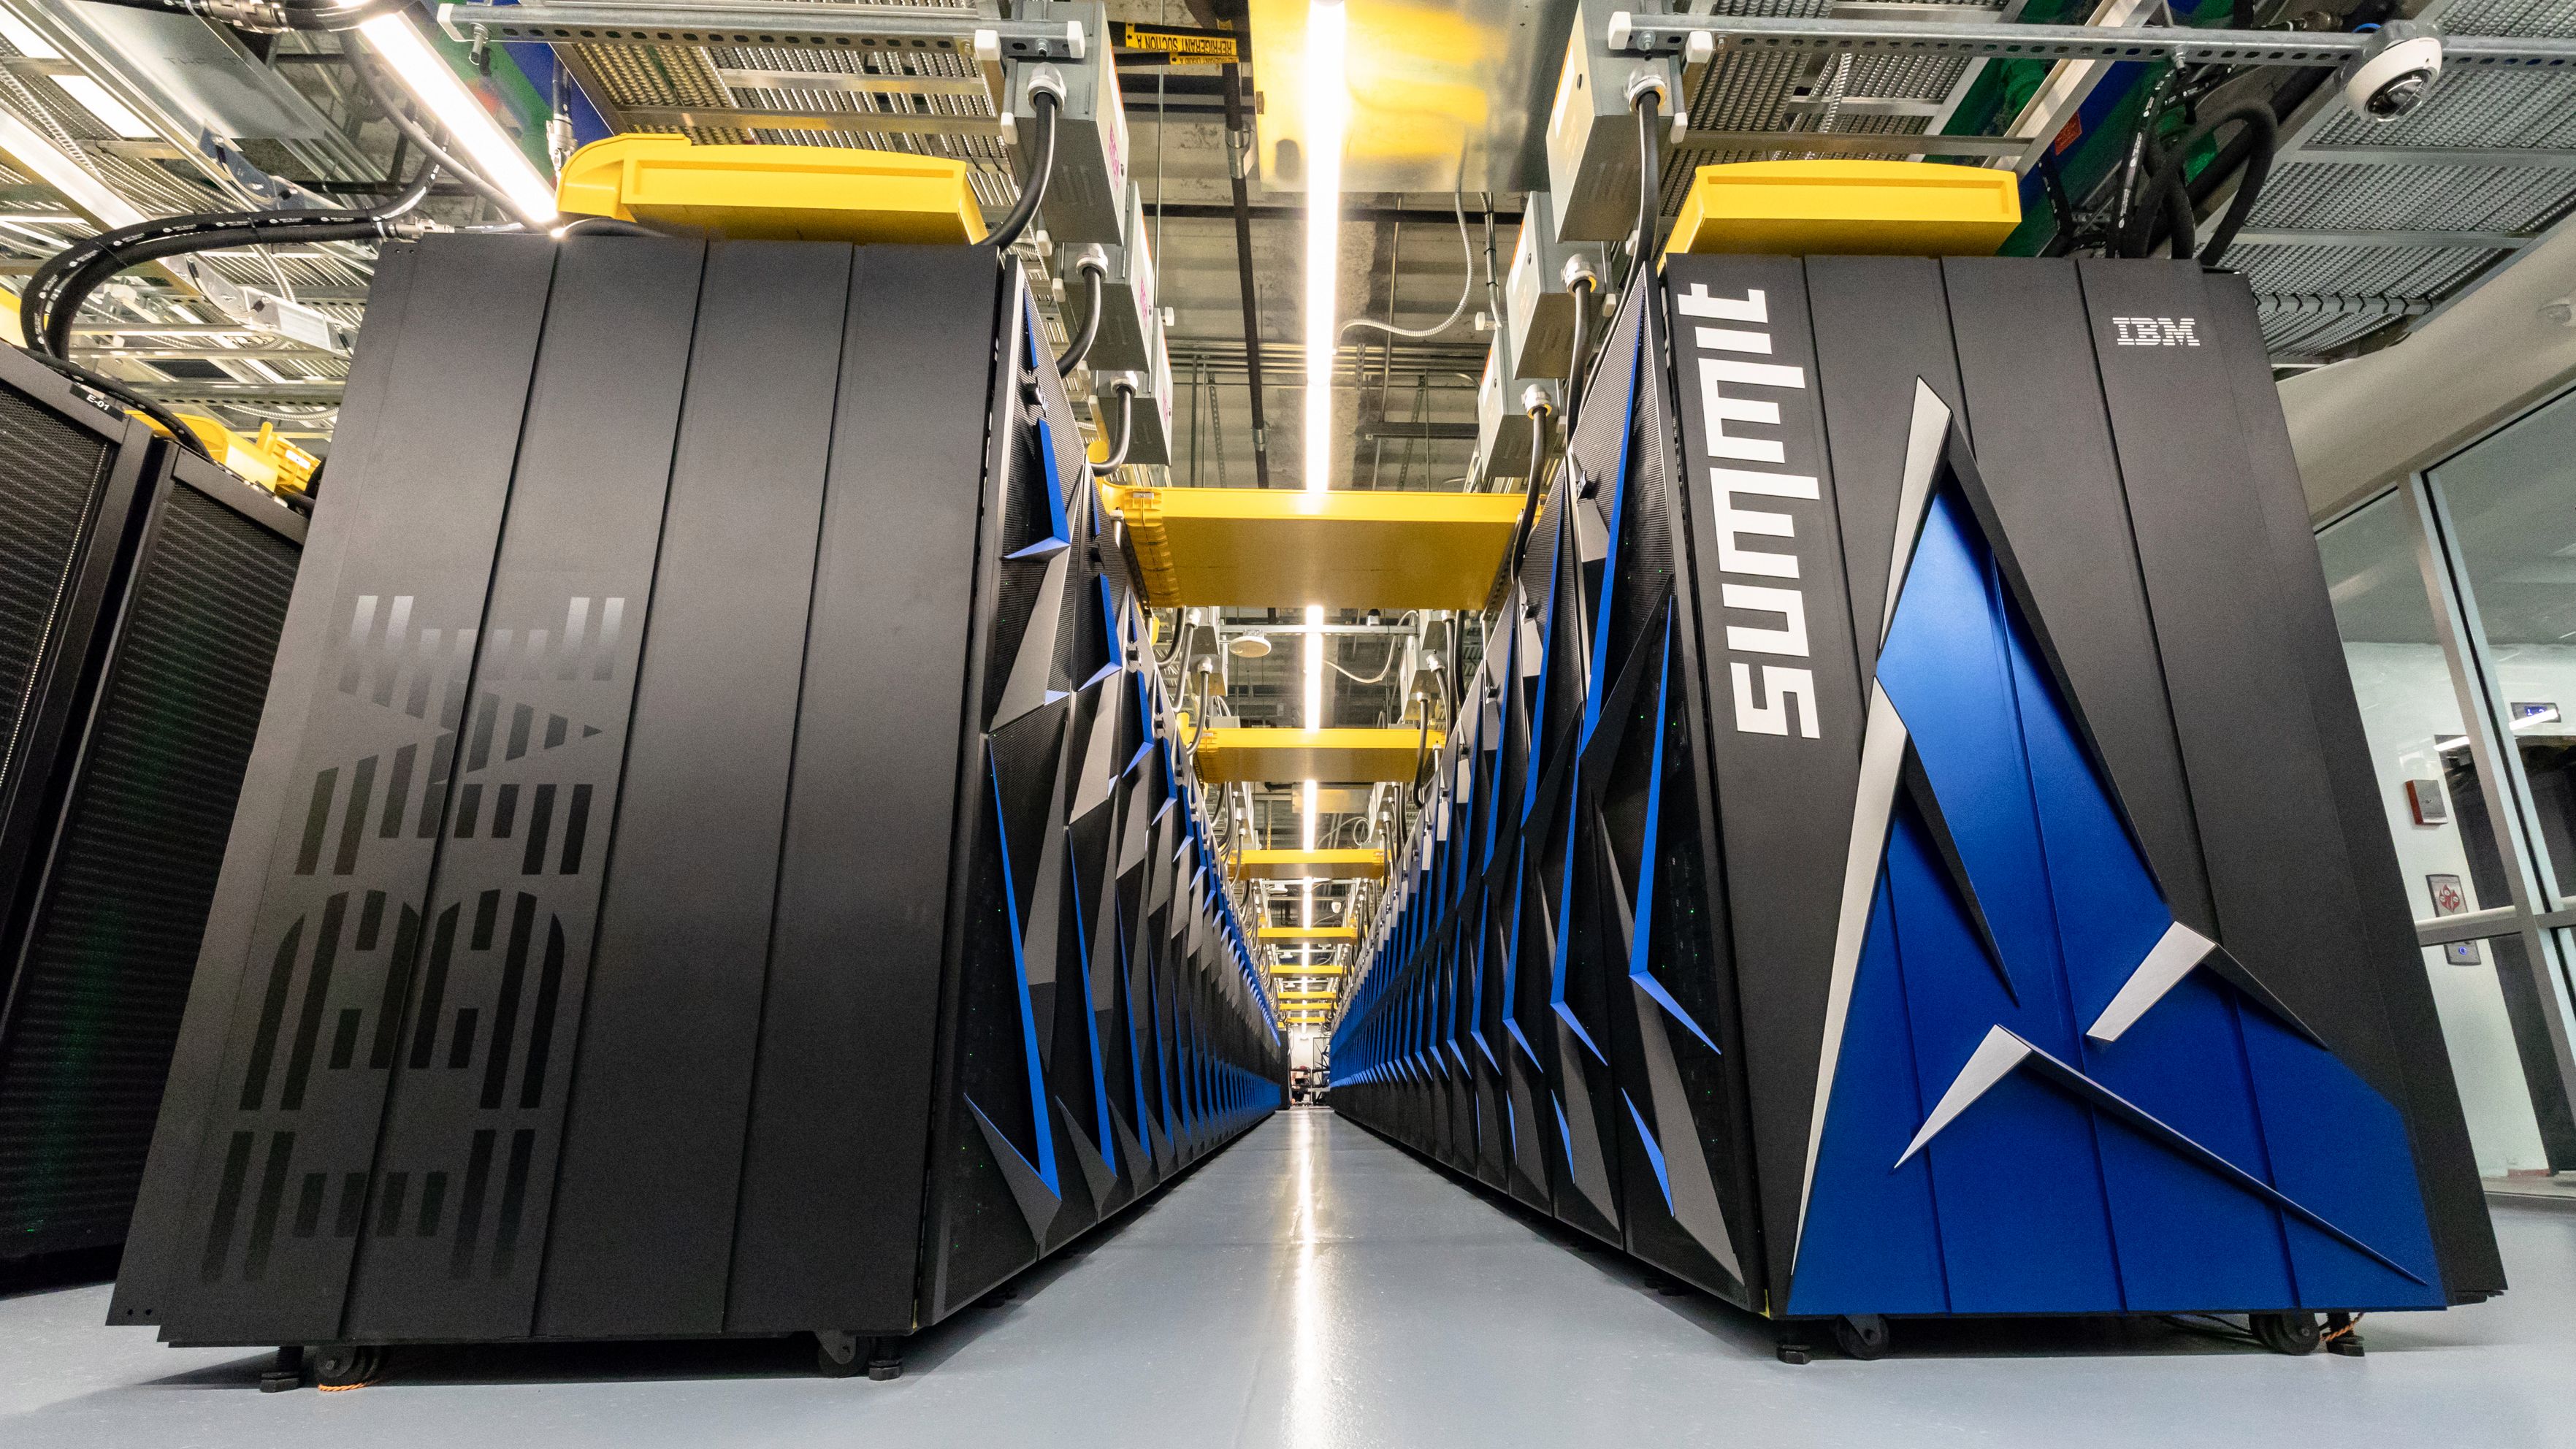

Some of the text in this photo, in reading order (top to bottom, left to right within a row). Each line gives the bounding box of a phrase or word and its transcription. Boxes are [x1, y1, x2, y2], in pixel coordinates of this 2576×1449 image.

[1136, 35, 1232, 56] REFRIGERANT SUCTION A
[2112, 317, 2201, 346] IBM
[86, 394, 110, 410] E-01
[1677, 283, 1821, 740] summit
[199, 595, 625, 1283] IBM
